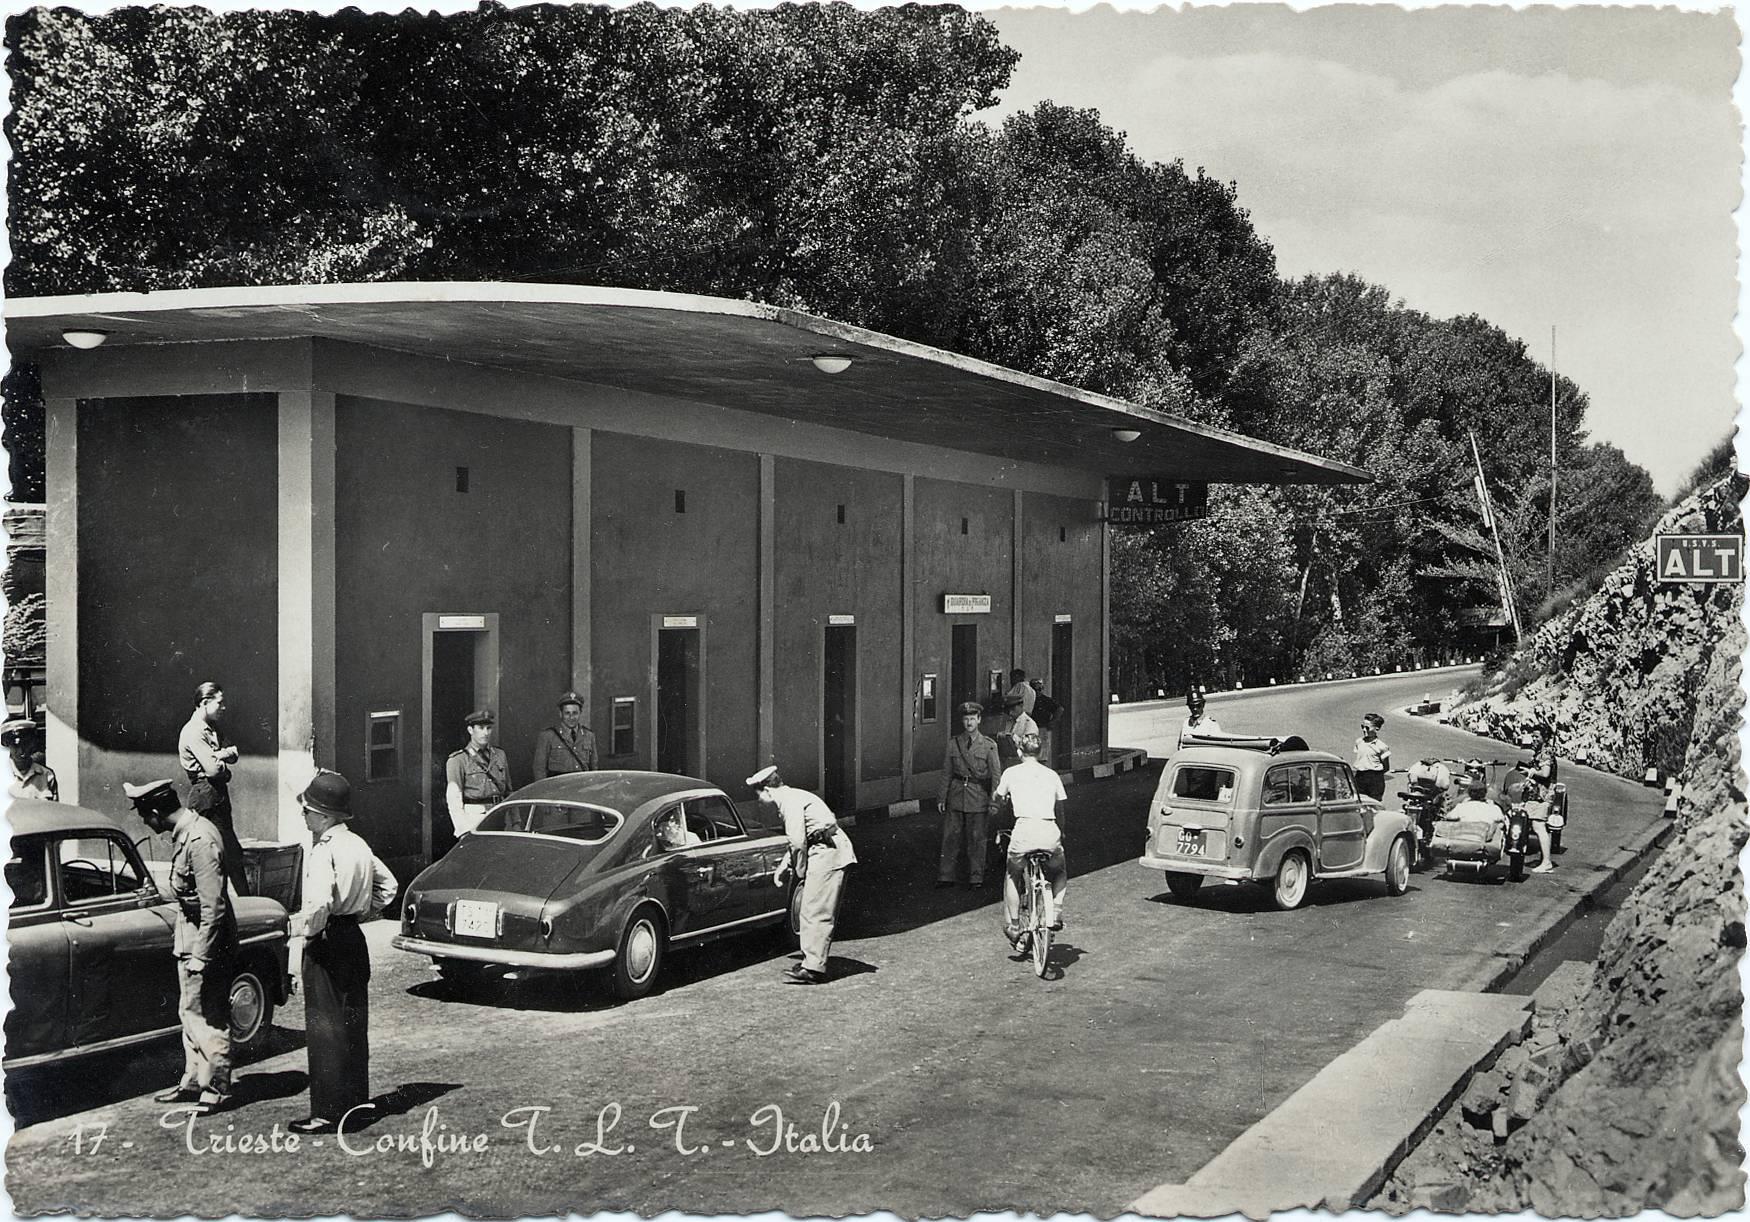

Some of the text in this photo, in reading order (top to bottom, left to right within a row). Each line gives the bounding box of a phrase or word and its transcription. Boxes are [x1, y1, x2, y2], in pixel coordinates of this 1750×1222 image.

[1126, 480, 1190, 504] ALT
[1664, 548, 1736, 577] ALT
[1177, 841, 1206, 856] 7794
